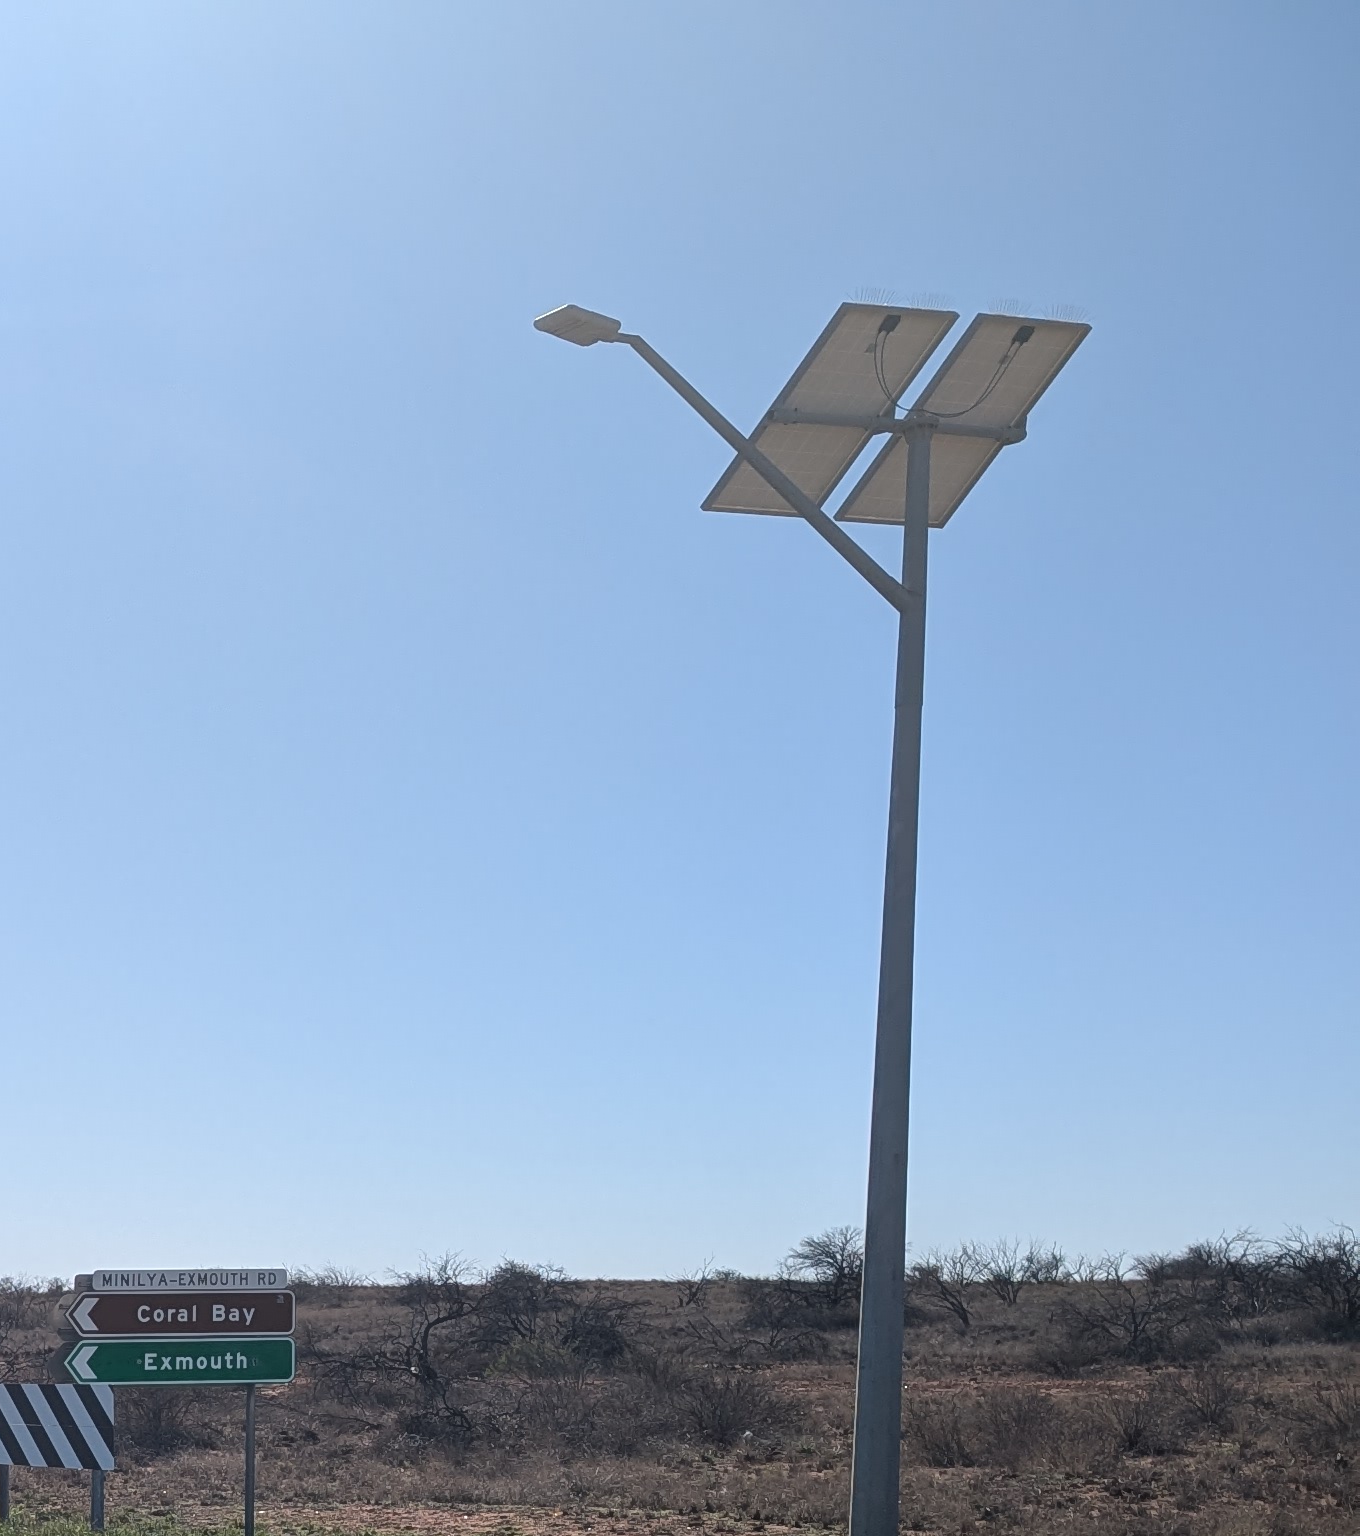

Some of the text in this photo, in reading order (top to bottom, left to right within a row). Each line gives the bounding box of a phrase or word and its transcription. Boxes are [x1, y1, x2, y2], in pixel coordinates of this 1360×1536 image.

[101, 1271, 277, 1287] MINILYA-EXMOUTH RD
[137, 1304, 256, 1326] Coral Bay
[143, 1352, 248, 1371] Exmouth
